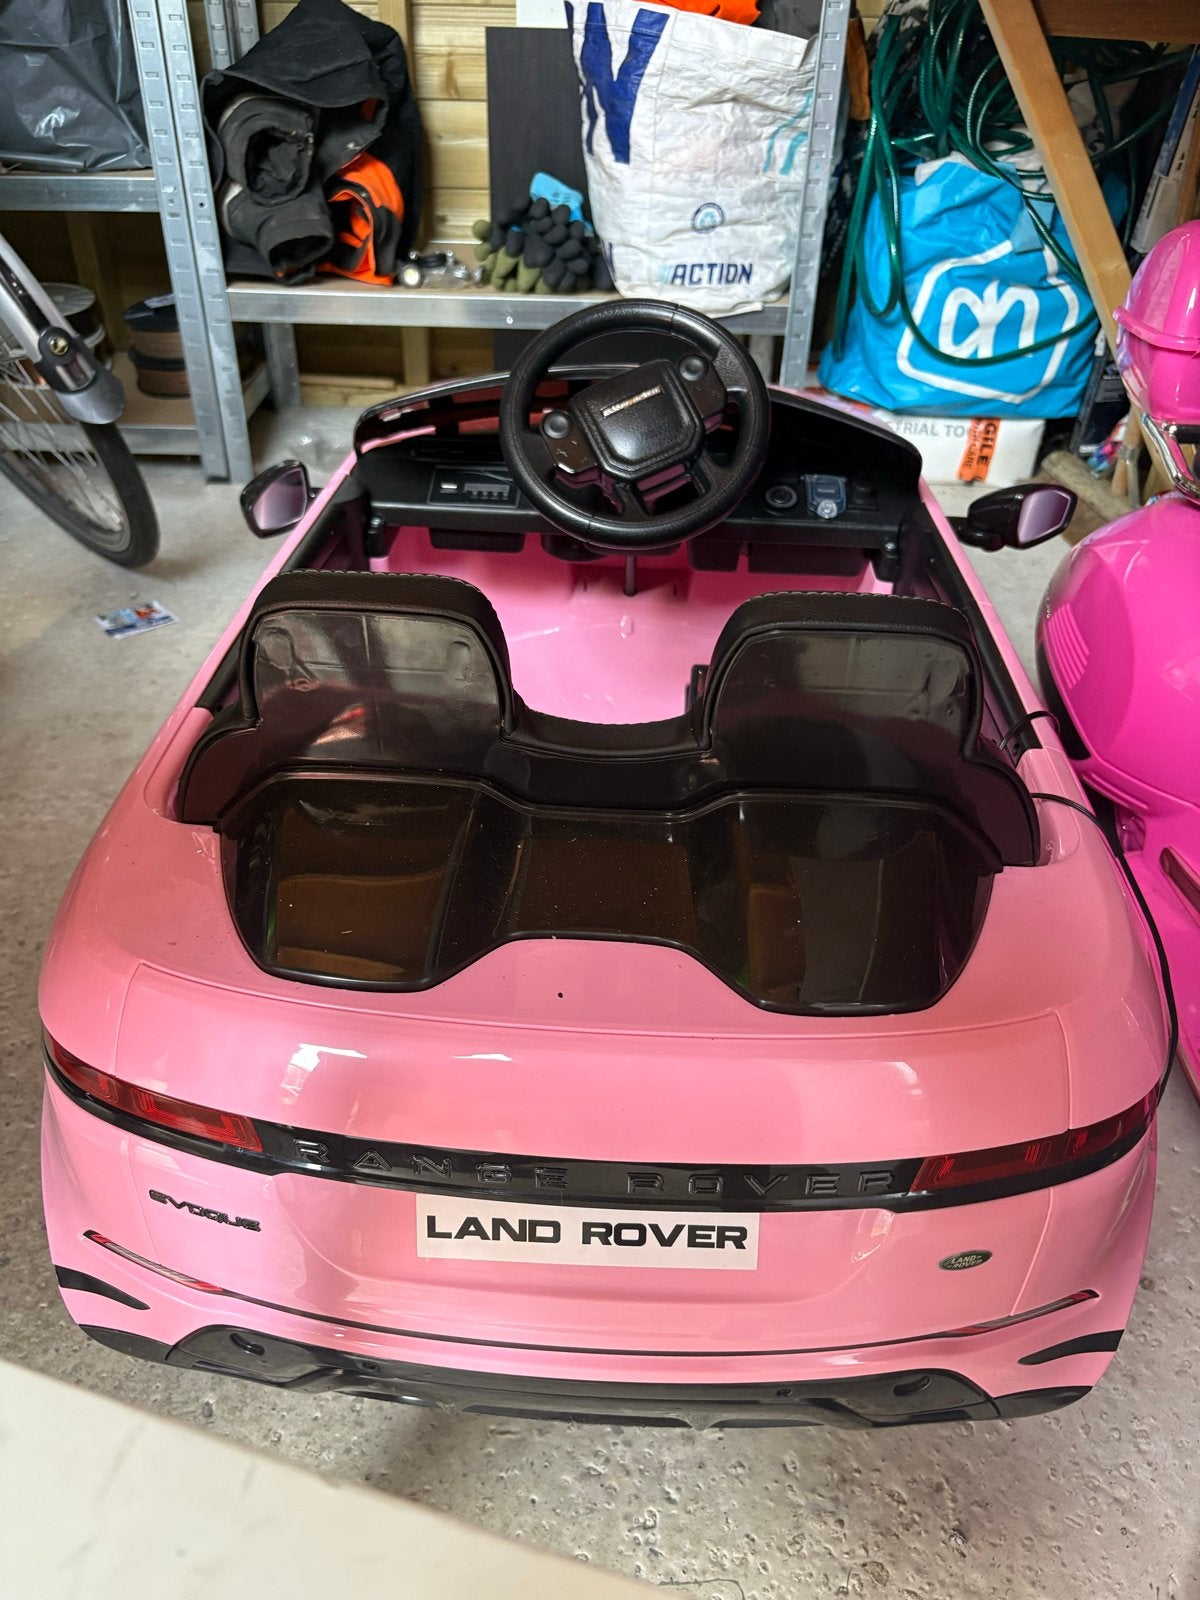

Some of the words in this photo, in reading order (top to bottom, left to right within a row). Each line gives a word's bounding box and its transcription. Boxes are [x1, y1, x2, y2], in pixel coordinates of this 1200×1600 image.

[669, 262, 753, 286] ACTION
[944, 424, 967, 438] TO
[976, 422, 997, 466] GILE
[293, 1139, 570, 1189] RANGE
[626, 1171, 896, 1196] ROVER
[148, 1189, 262, 1232] EVOQUE
[426, 1214, 562, 1244] LAND
[581, 1221, 748, 1250] ROVER
